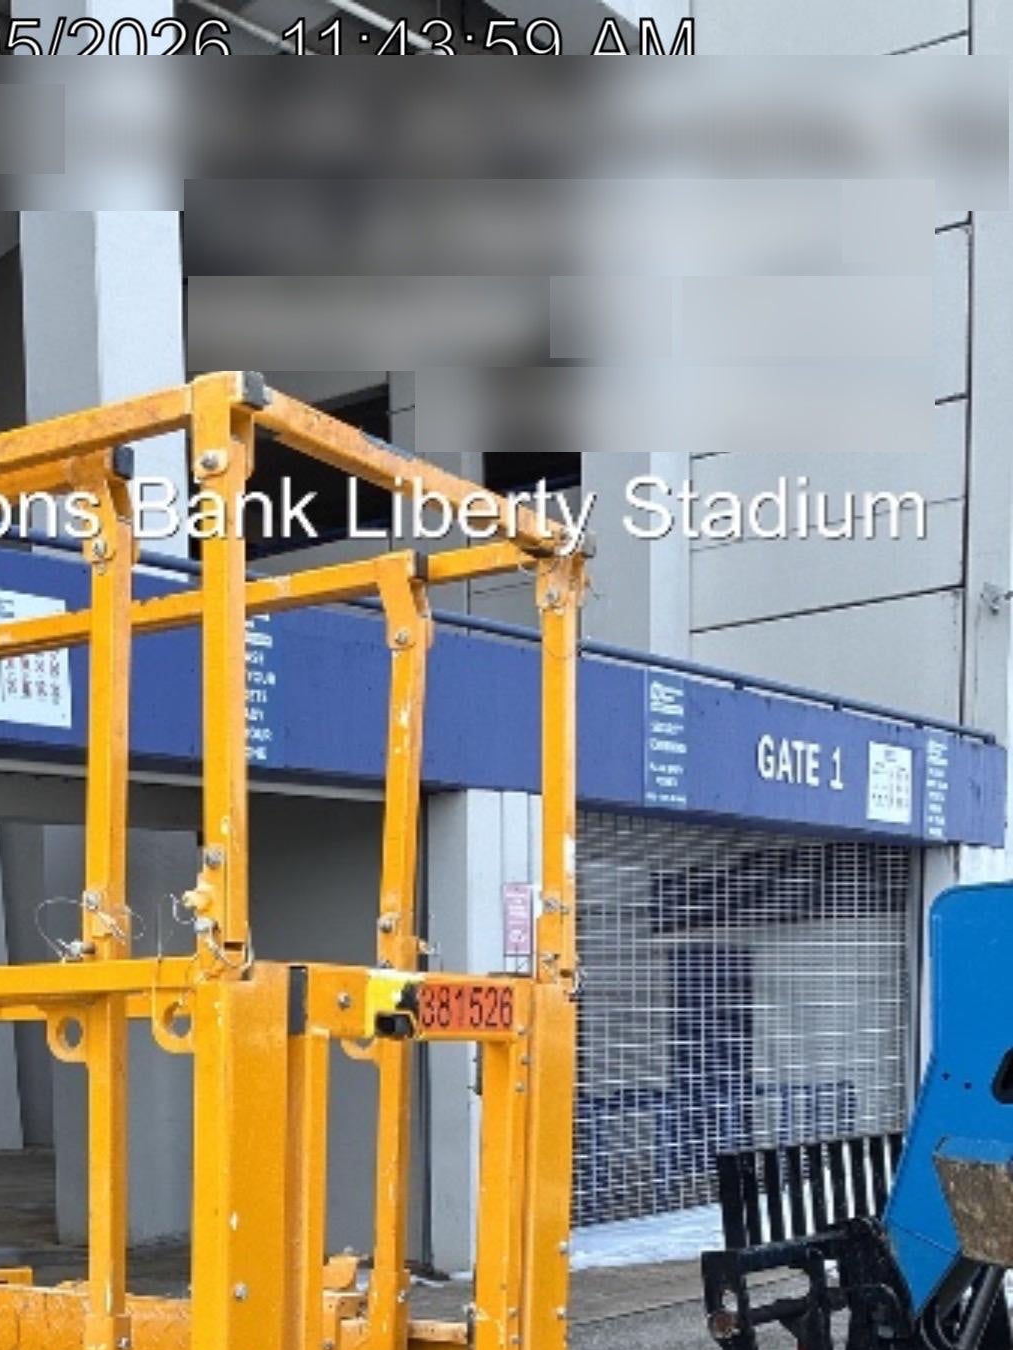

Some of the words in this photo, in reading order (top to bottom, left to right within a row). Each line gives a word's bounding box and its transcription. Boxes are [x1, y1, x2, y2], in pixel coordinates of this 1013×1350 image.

[757, 734, 821, 787] GATE
[829, 746, 844, 790] 1
[420, 985, 514, 1028] 381526
